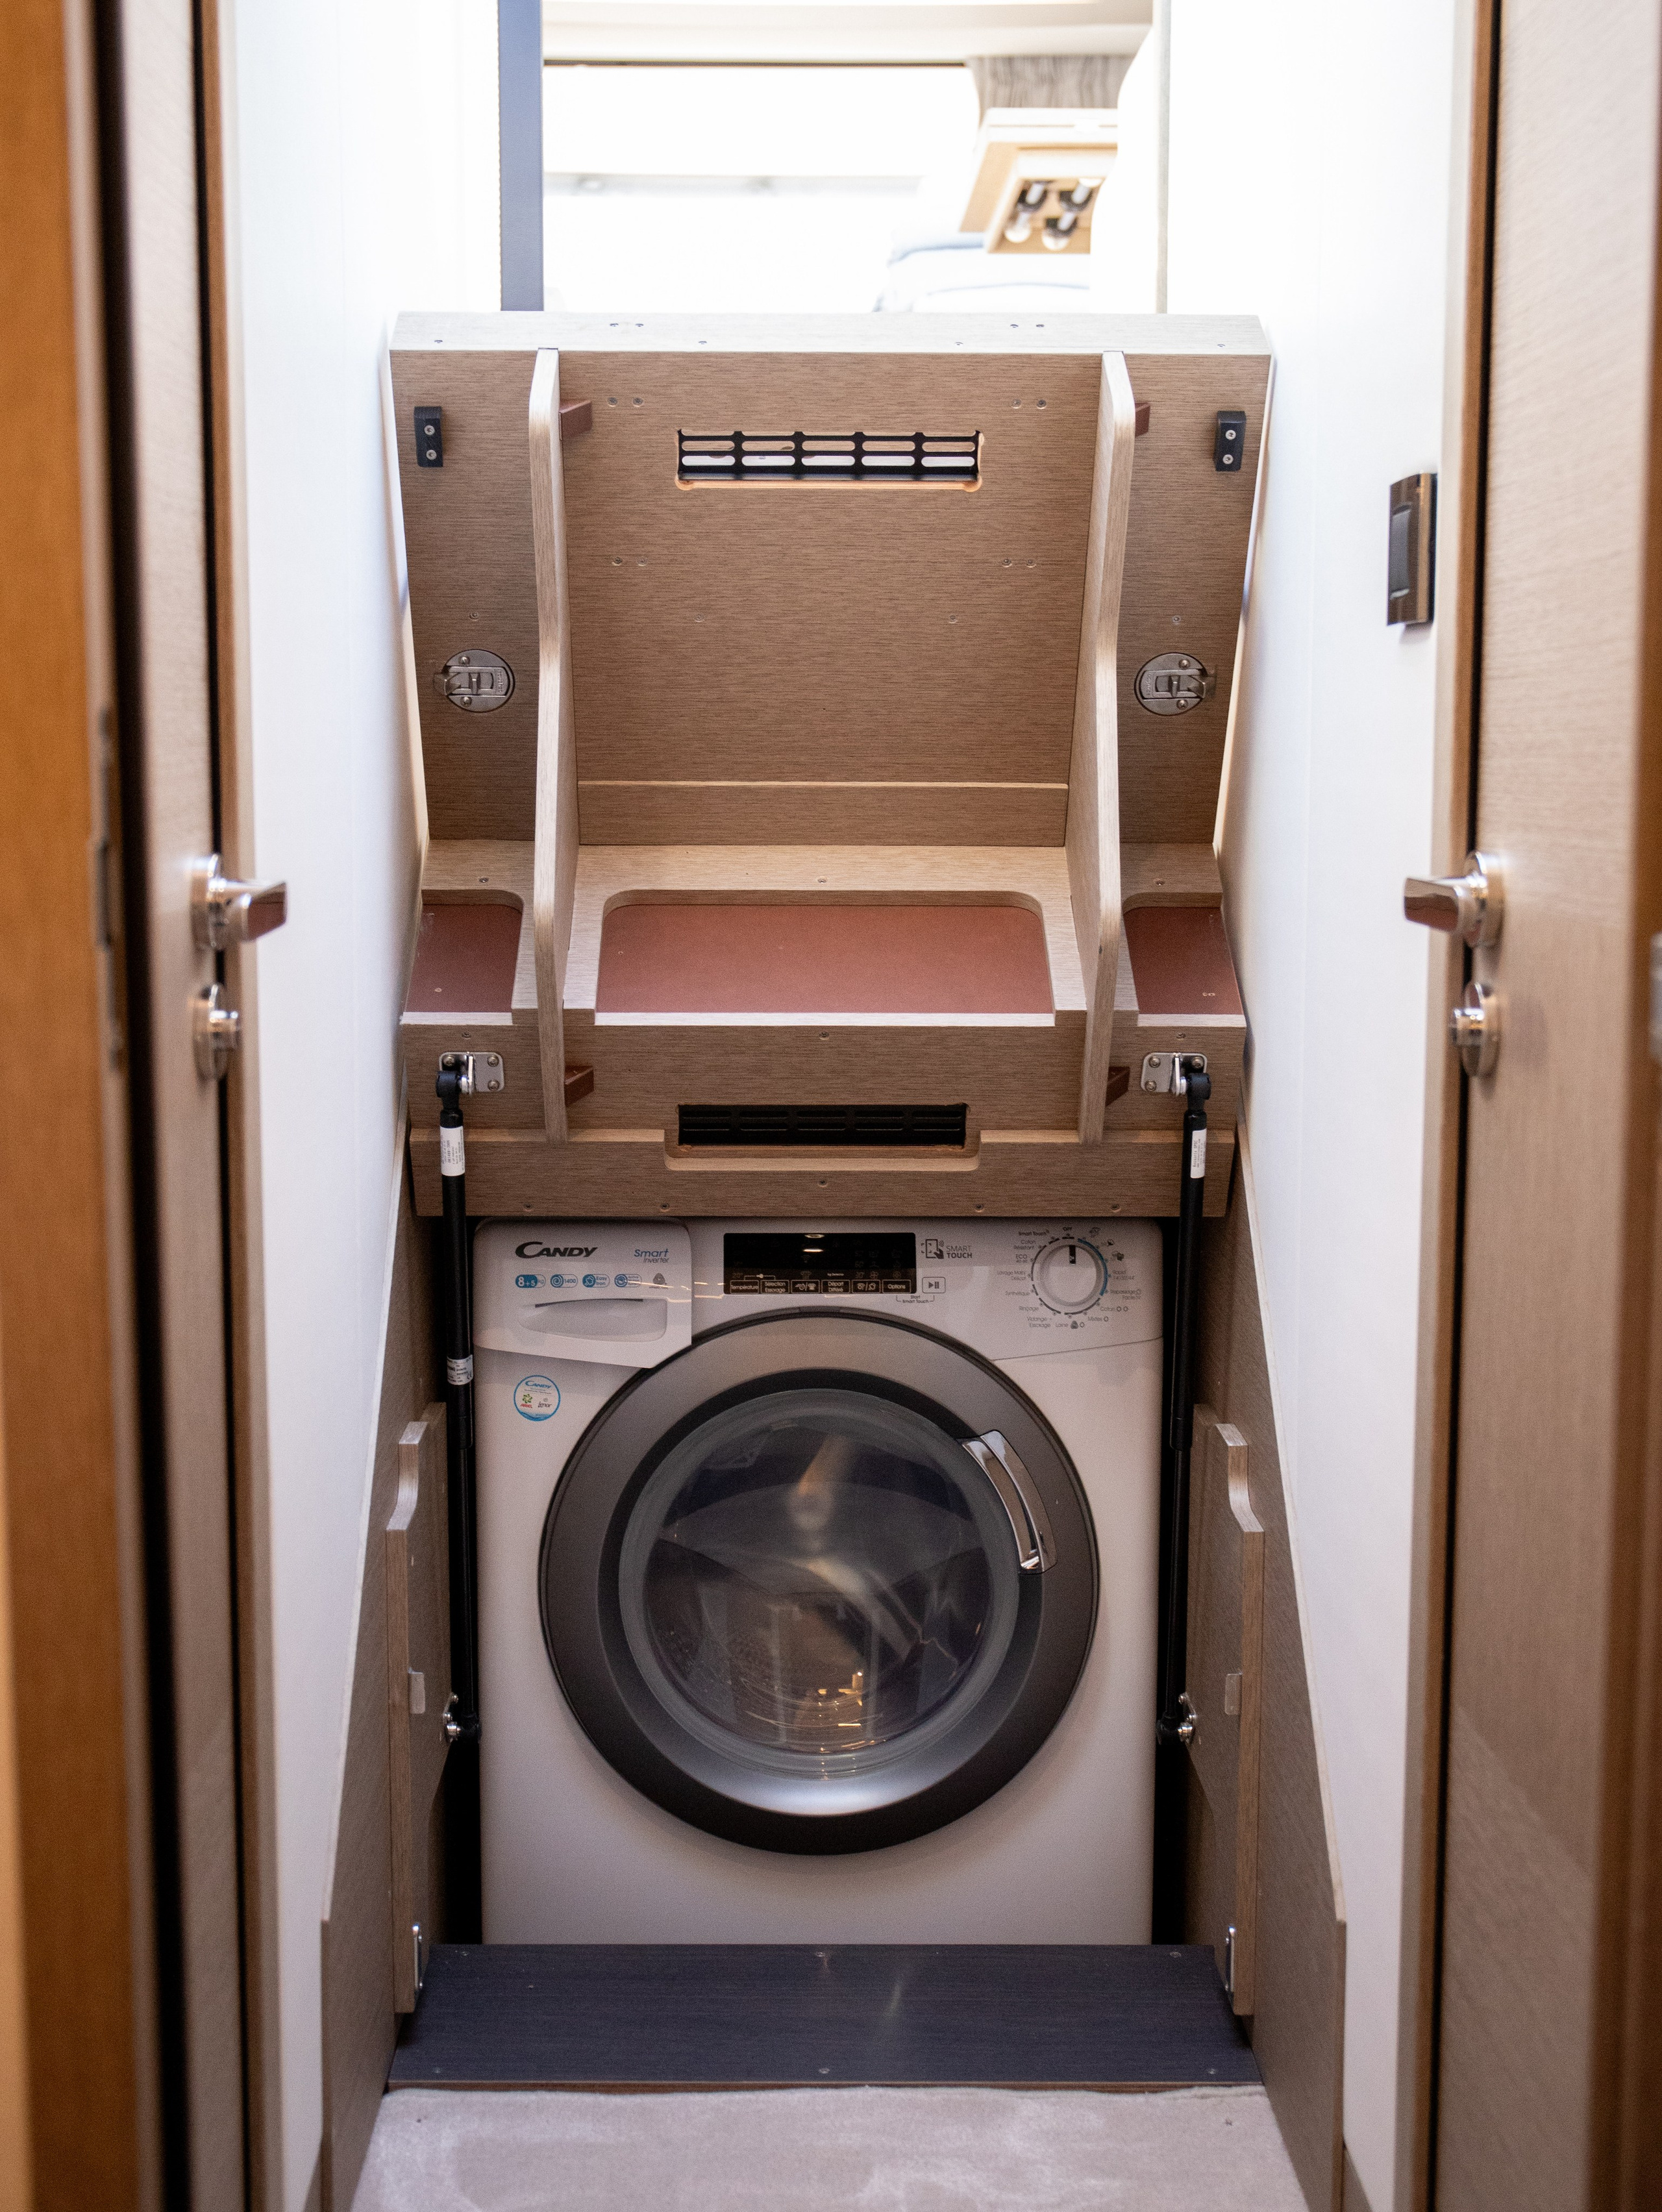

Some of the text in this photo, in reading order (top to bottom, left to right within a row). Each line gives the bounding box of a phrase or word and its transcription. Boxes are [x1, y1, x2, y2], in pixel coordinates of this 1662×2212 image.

[515, 1241, 598, 1258] CANDY
[634, 1249, 669, 1258] Smart
[525, 1380, 551, 1389] CANDY
